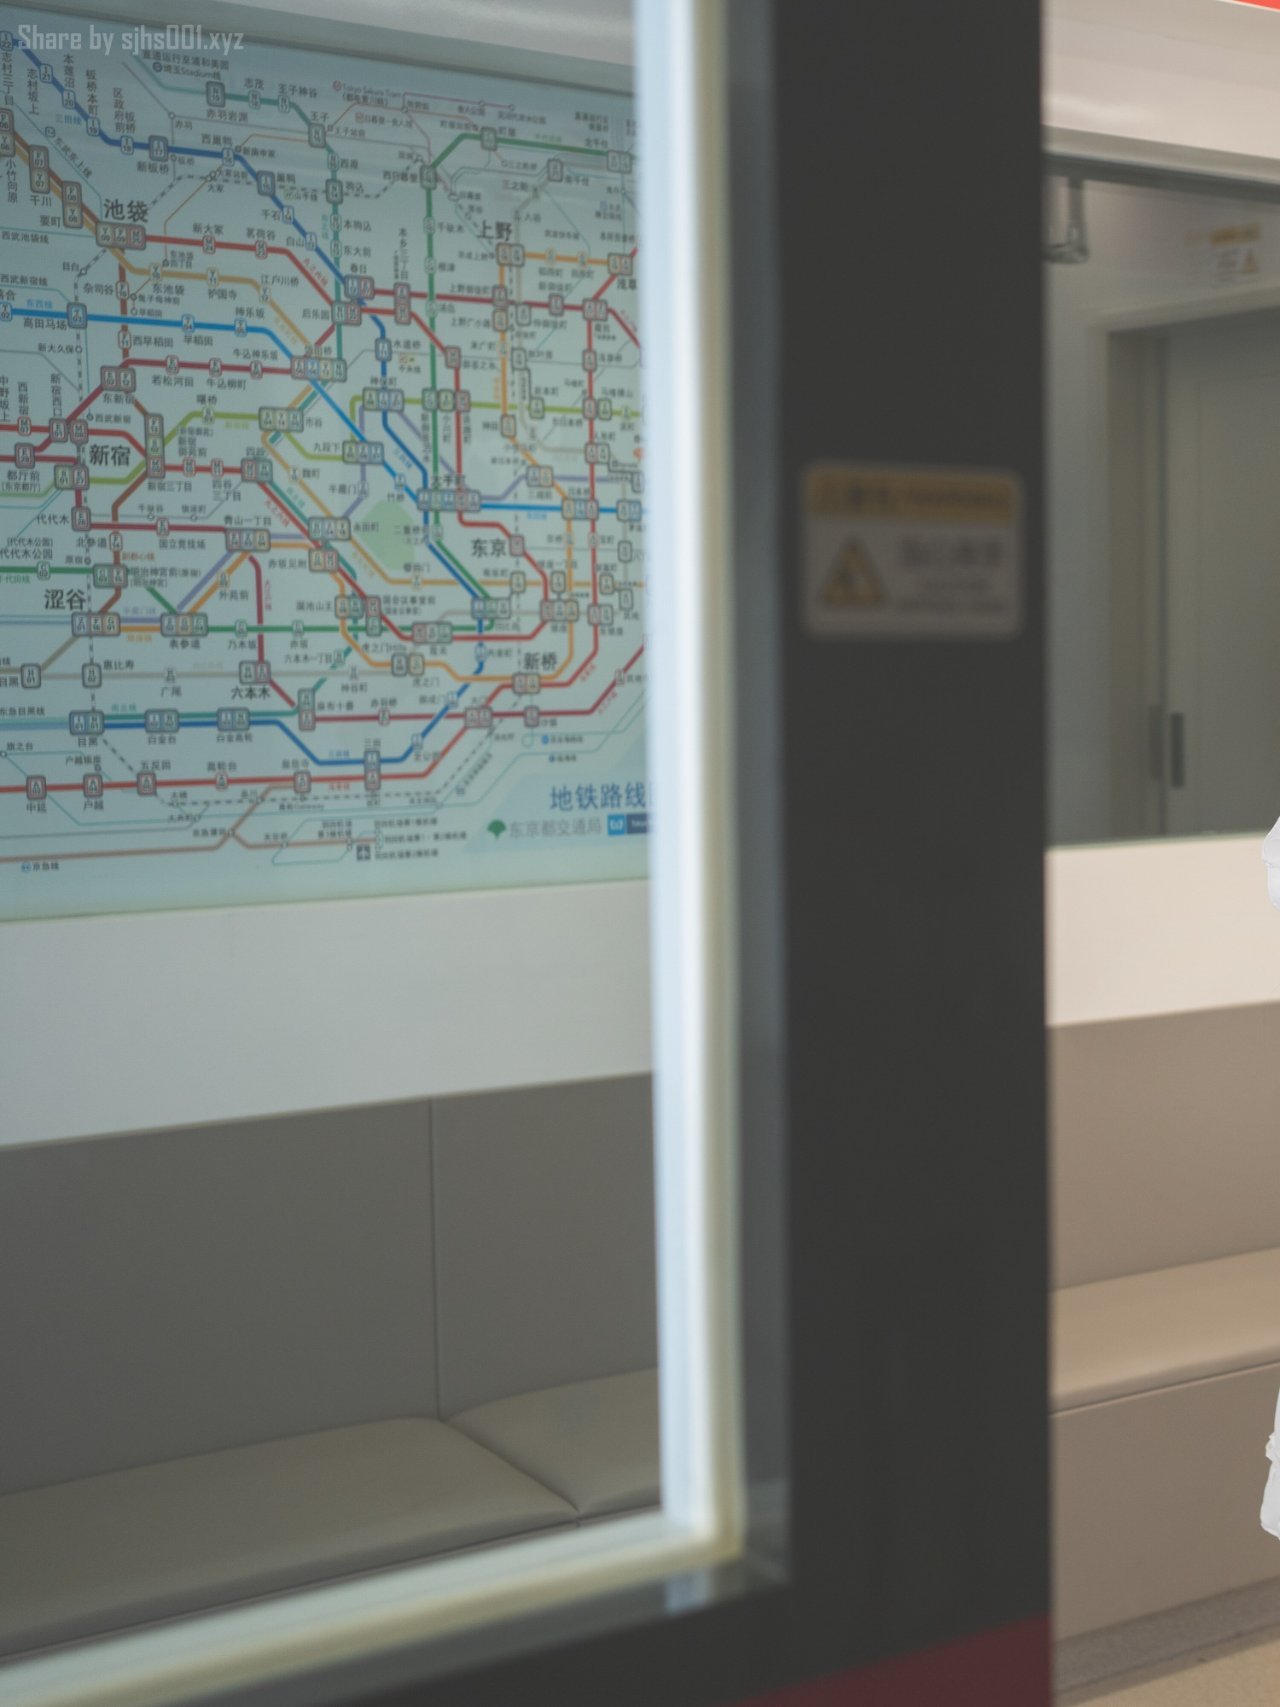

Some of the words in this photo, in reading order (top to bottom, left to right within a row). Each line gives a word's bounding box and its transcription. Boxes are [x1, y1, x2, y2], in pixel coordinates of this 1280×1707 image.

[27, 68, 39, 115] 志村坂上
[86, 69, 98, 116] 板桥本町
[5, 159, 18, 203] 小竹向原
[104, 199, 149, 223] 池袋
[2, 230, 49, 244] 西武池袋线
[477, 219, 512, 242] 上野
[23, 317, 67, 330] 高田马场
[184, 335, 213, 346] 早稻田
[152, 375, 194, 388] 若松河田
[50, 373, 62, 416] 新宿西口
[89, 444, 130, 467] 新宿
[7, 470, 40, 481] 都厅前
[37, 514, 69, 525] 代代木
[471, 539, 507, 558] 东京
[44, 589, 86, 611] 涩谷
[524, 652, 557, 670] 新桥
[231, 686, 271, 700] 六本木
[550, 782, 646, 811] 地铁路线
[510, 818, 602, 838] 东京都交通局
